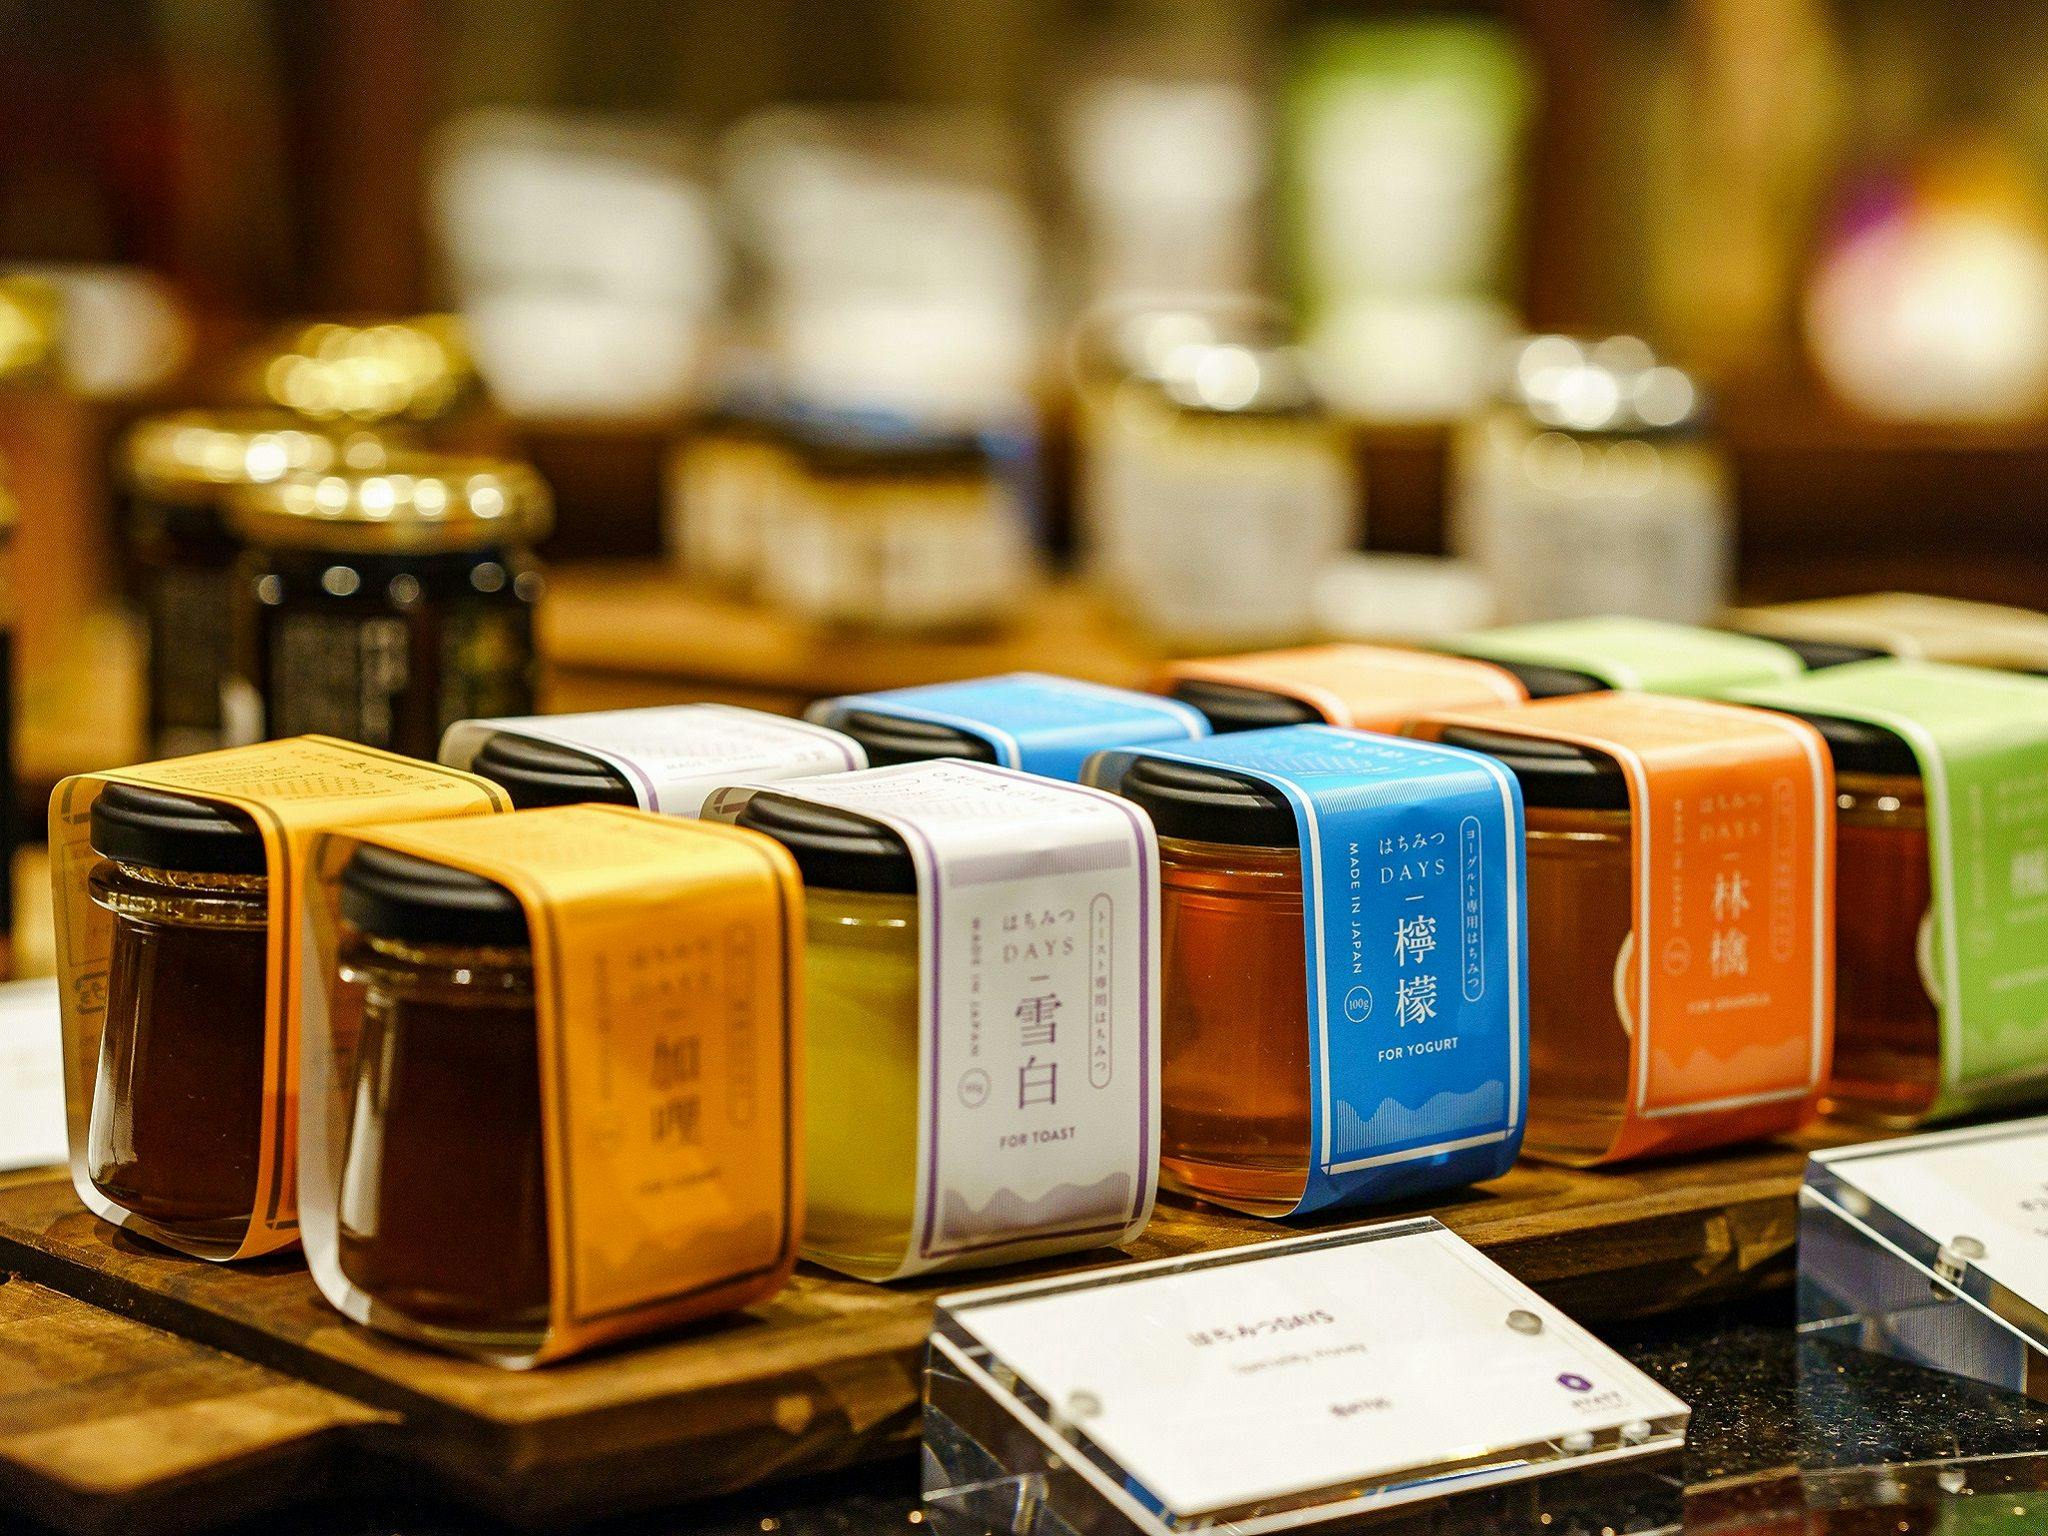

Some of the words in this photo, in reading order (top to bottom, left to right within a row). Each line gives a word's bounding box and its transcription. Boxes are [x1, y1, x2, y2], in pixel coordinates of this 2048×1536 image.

[1379, 832, 1445, 855] はちみつ
[1349, 843, 1361, 889] MADE
[1380, 858, 1446, 884] DAYS
[1351, 896, 1361, 914] IN
[1002, 909, 1076, 932] はちみつ
[1002, 935, 1075, 964] DAYS
[1351, 921, 1362, 974] JAPAN
[1394, 914, 1438, 1028] 檸檬
[1014, 992, 1063, 1110] 雪白
[1379, 1046, 1403, 1063] FOR
[1407, 1037, 1458, 1057] YOGURT
[999, 1132, 1028, 1150] FOR
[1032, 1125, 1076, 1144] TOAST
